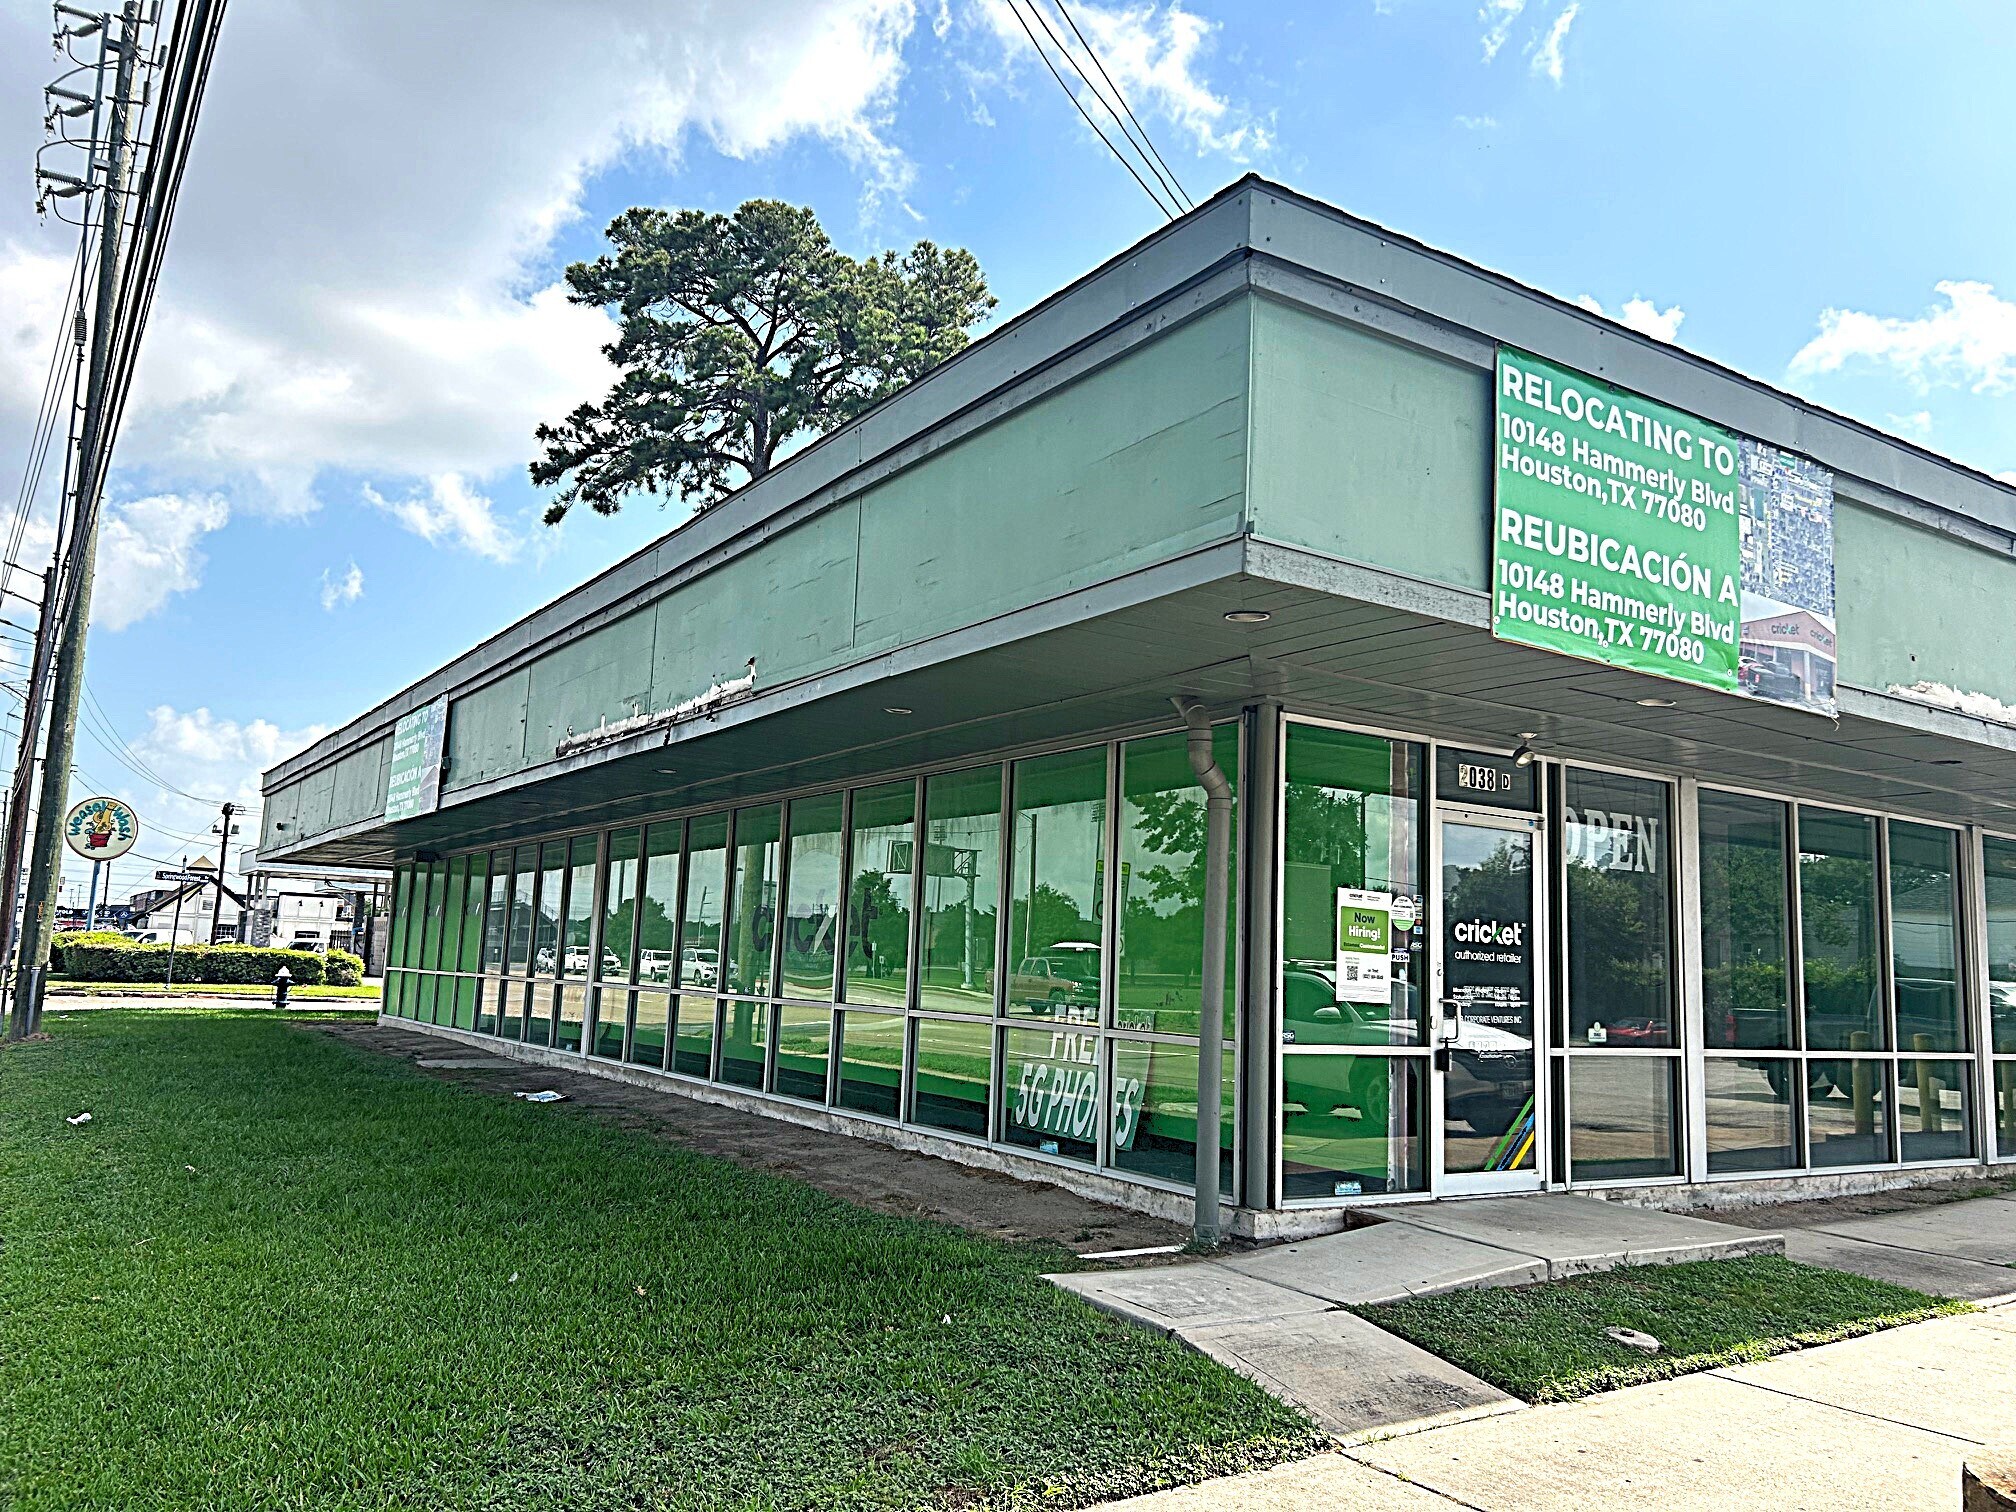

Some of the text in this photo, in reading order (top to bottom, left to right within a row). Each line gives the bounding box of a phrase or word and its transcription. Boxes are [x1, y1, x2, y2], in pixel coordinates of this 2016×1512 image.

[1502, 363, 1735, 476] RELOCATING TO
[1500, 412, 1735, 515] 10148 Hammerly Blvd
[1641, 489, 1706, 532] 77080
[1501, 507, 1739, 607] REUBICACIÓN A
[1498, 558, 1735, 645] 10148 Hammerly Blvd
[1639, 625, 1705, 665] 77080
[1771, 623, 1800, 635] cricket
[1460, 764, 1509, 791] 2038 D
[67, 800, 134, 841] Weasel Wash
[1565, 806, 1659, 874] OPEN
[1348, 925, 1381, 942] Hiring!
[1354, 912, 1376, 924] Now
[1454, 918, 1522, 946] cricket
[1391, 953, 1409, 961] PUSH
[1454, 950, 1522, 964] authorized retailer
[1050, 1003, 1099, 1066] FRE
[1015, 1062, 1048, 1128] 5G
